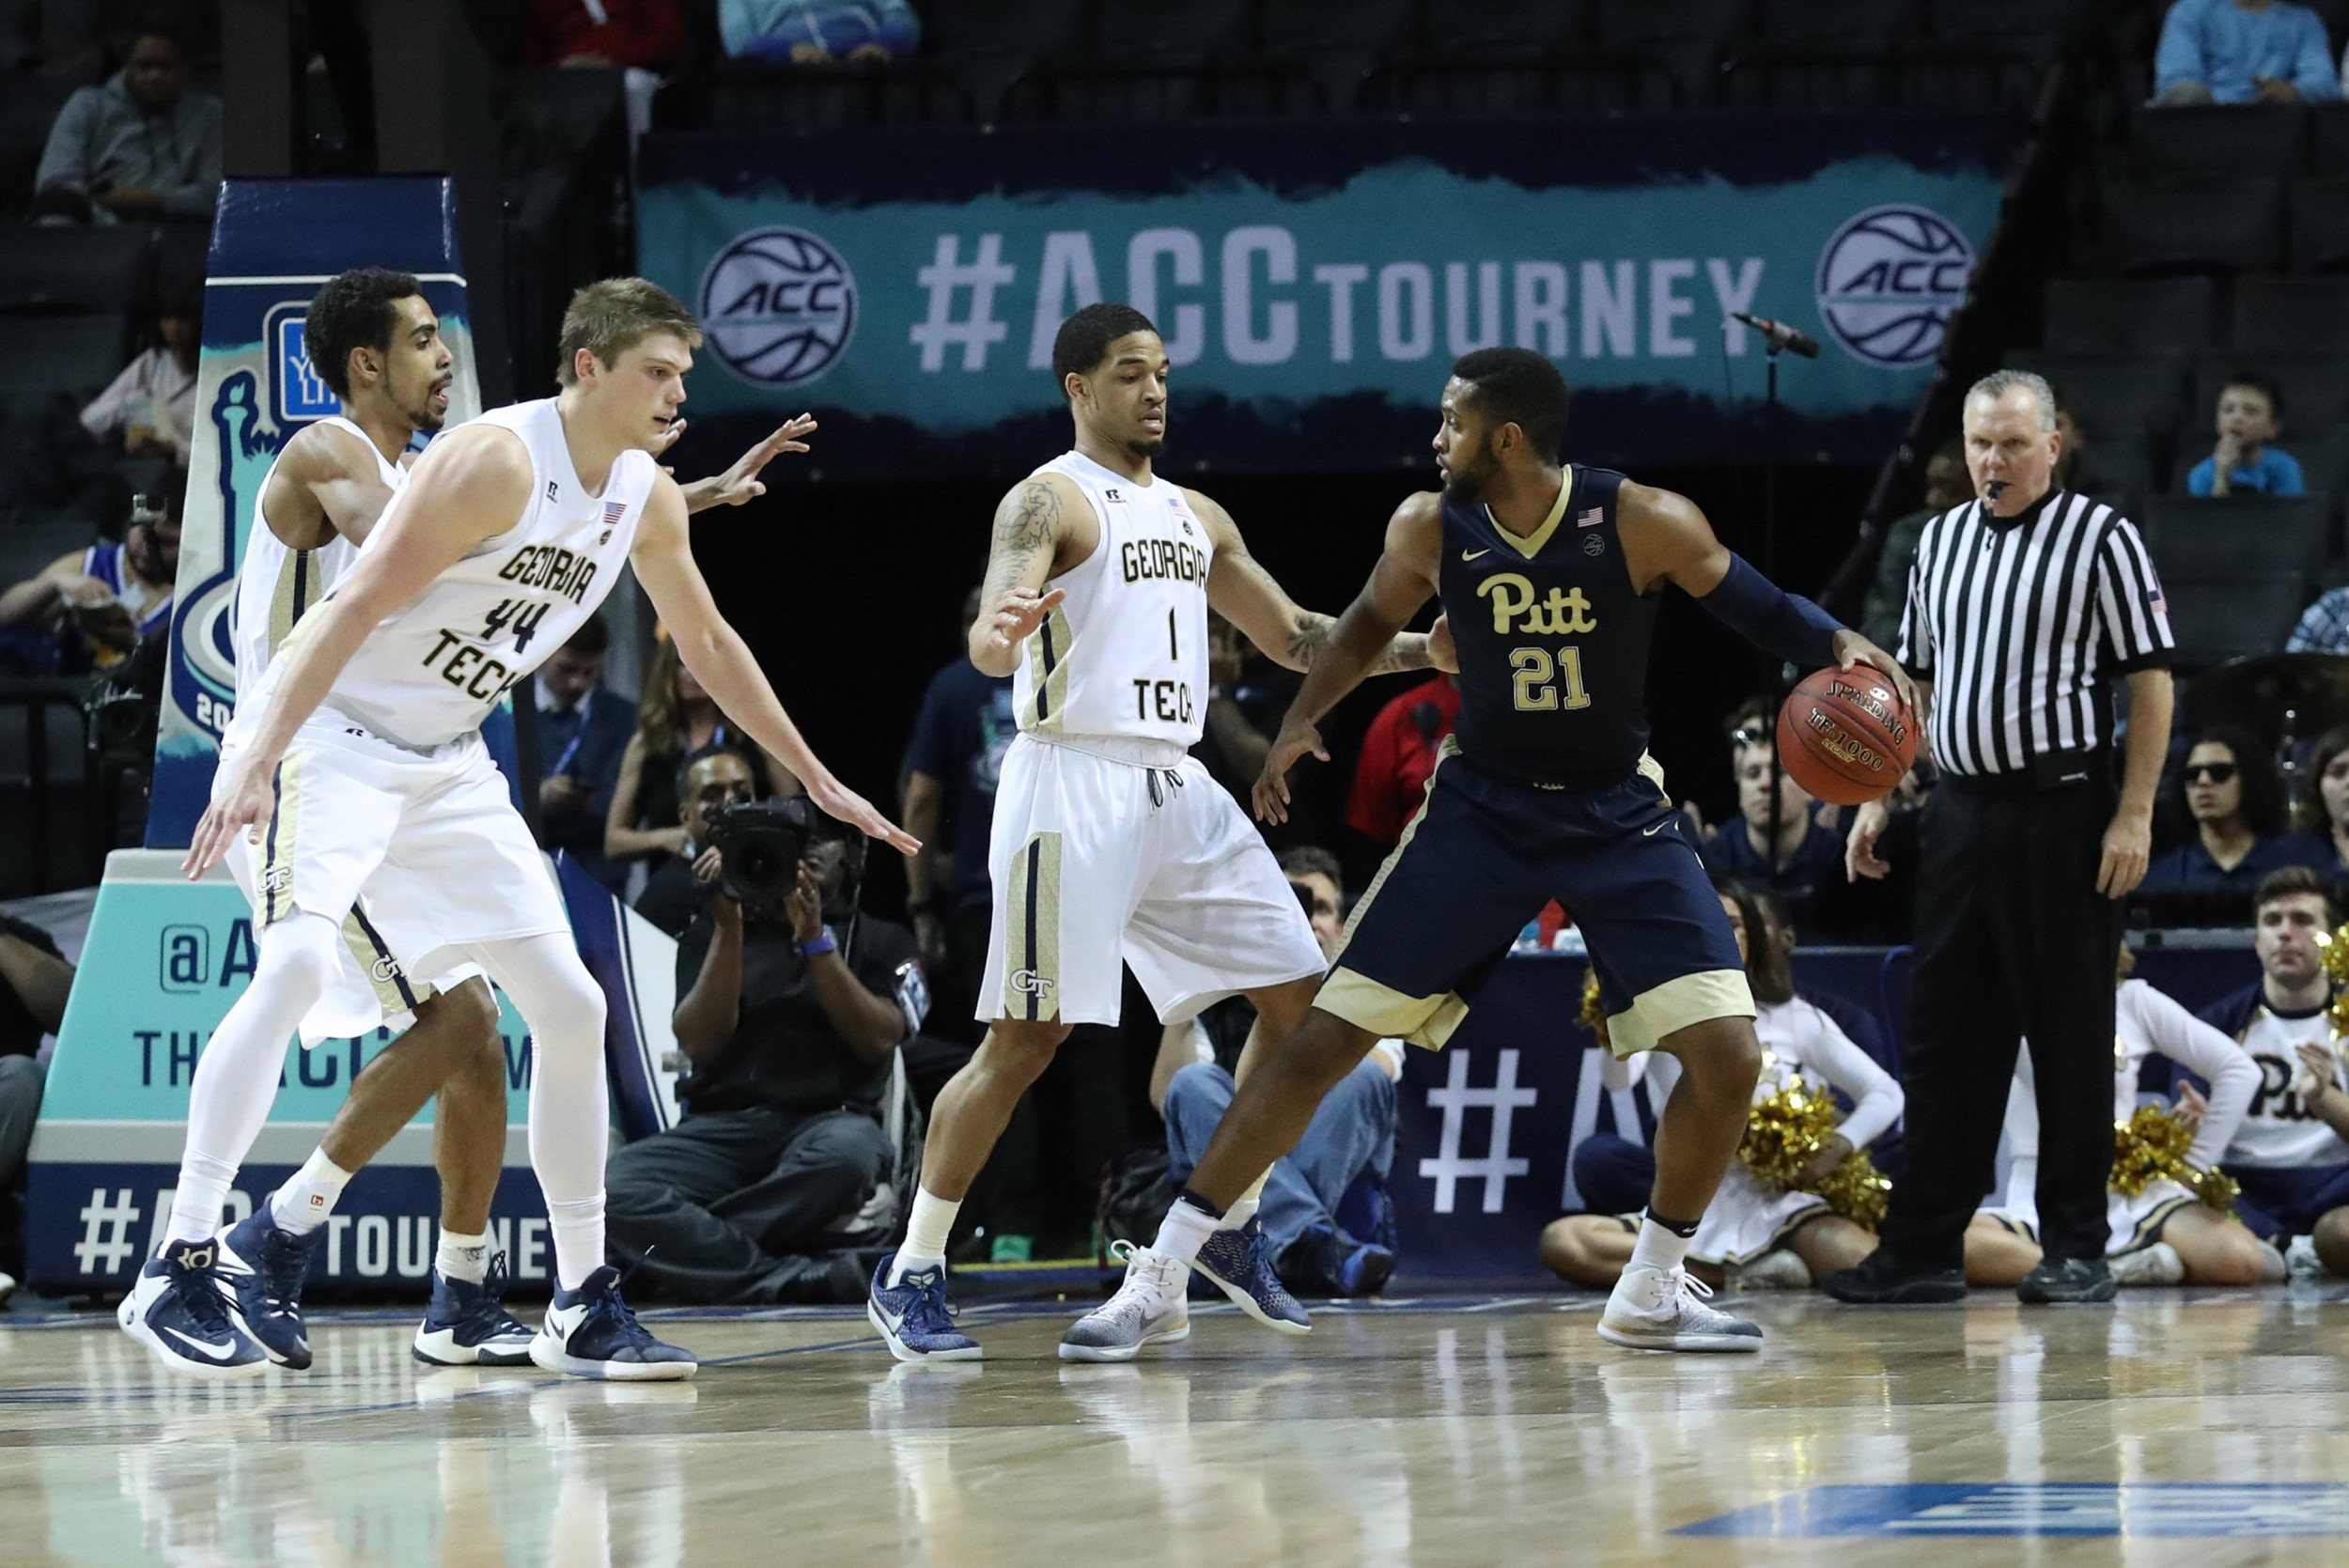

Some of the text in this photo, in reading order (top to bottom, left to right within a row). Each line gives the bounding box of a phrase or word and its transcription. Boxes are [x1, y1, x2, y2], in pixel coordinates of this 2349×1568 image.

[722, 280, 844, 316] ACC
[1839, 259, 1967, 295] ACC
[1121, 538, 1207, 592] GEORGIA
[480, 598, 552, 655] 44
[1476, 572, 1597, 635] Pitt
[1168, 604, 1178, 661] 1
[421, 627, 527, 706] TECH
[1508, 645, 1592, 711] 21
[1132, 676, 1198, 726] TECH
[1823, 679, 1908, 750] SPALDING
[1009, 968, 1054, 999] GT
